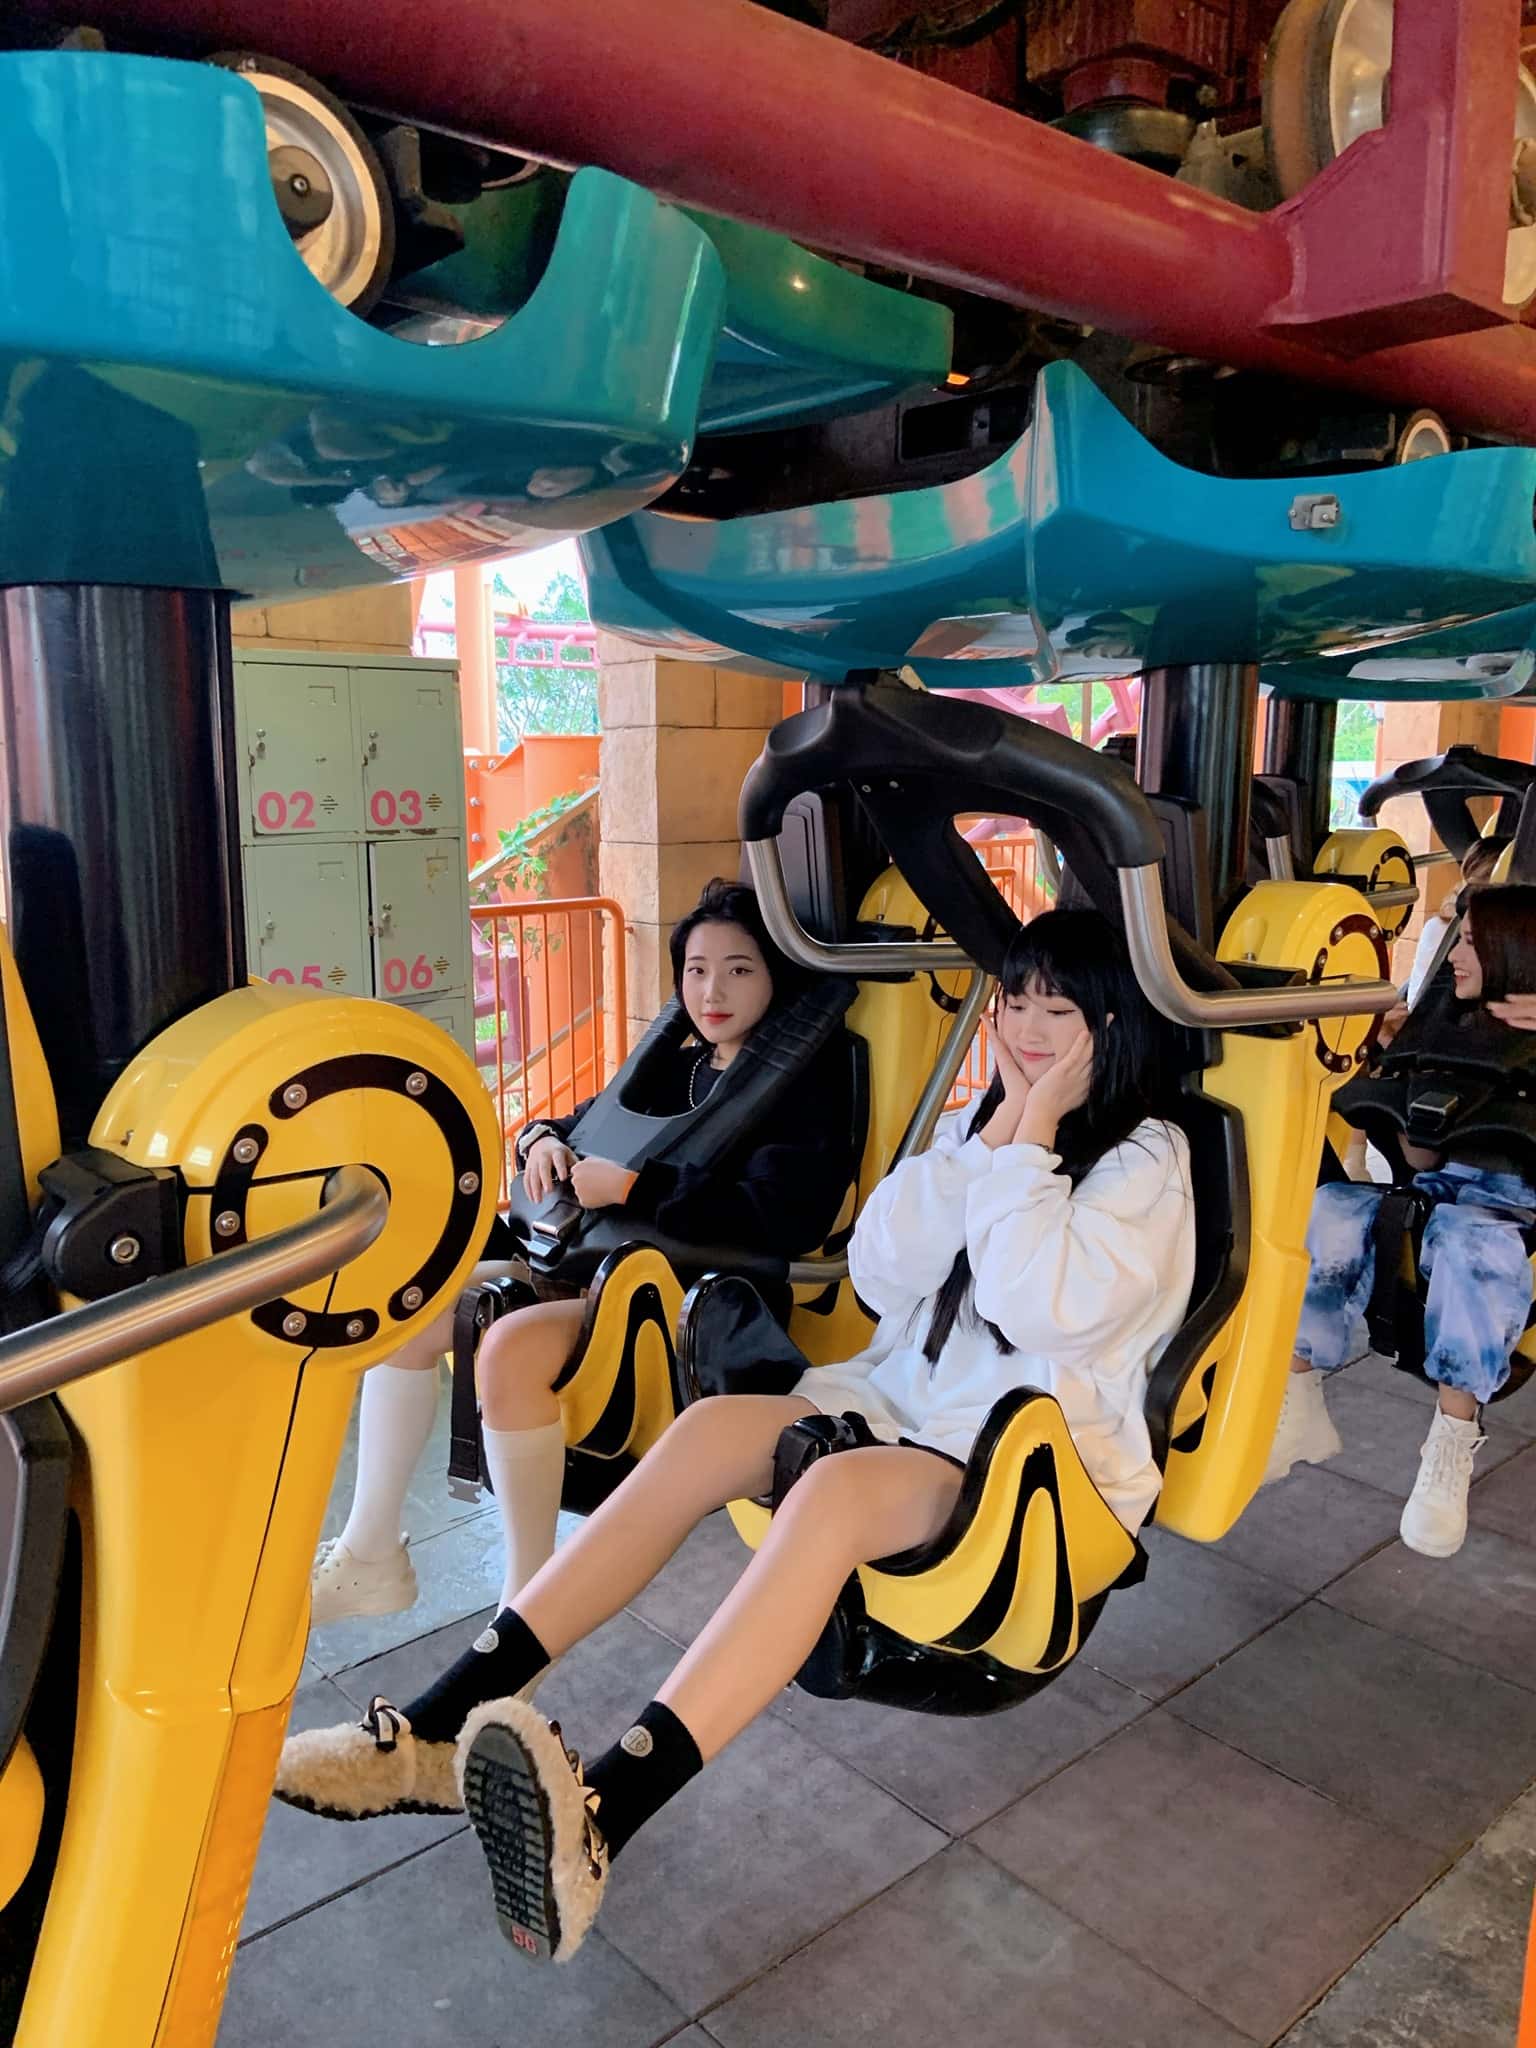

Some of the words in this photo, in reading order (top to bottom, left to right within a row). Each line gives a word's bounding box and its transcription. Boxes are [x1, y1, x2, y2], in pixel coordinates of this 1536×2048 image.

[258, 791, 316, 830] 02
[370, 790, 423, 827] 03
[383, 954, 433, 994] 06
